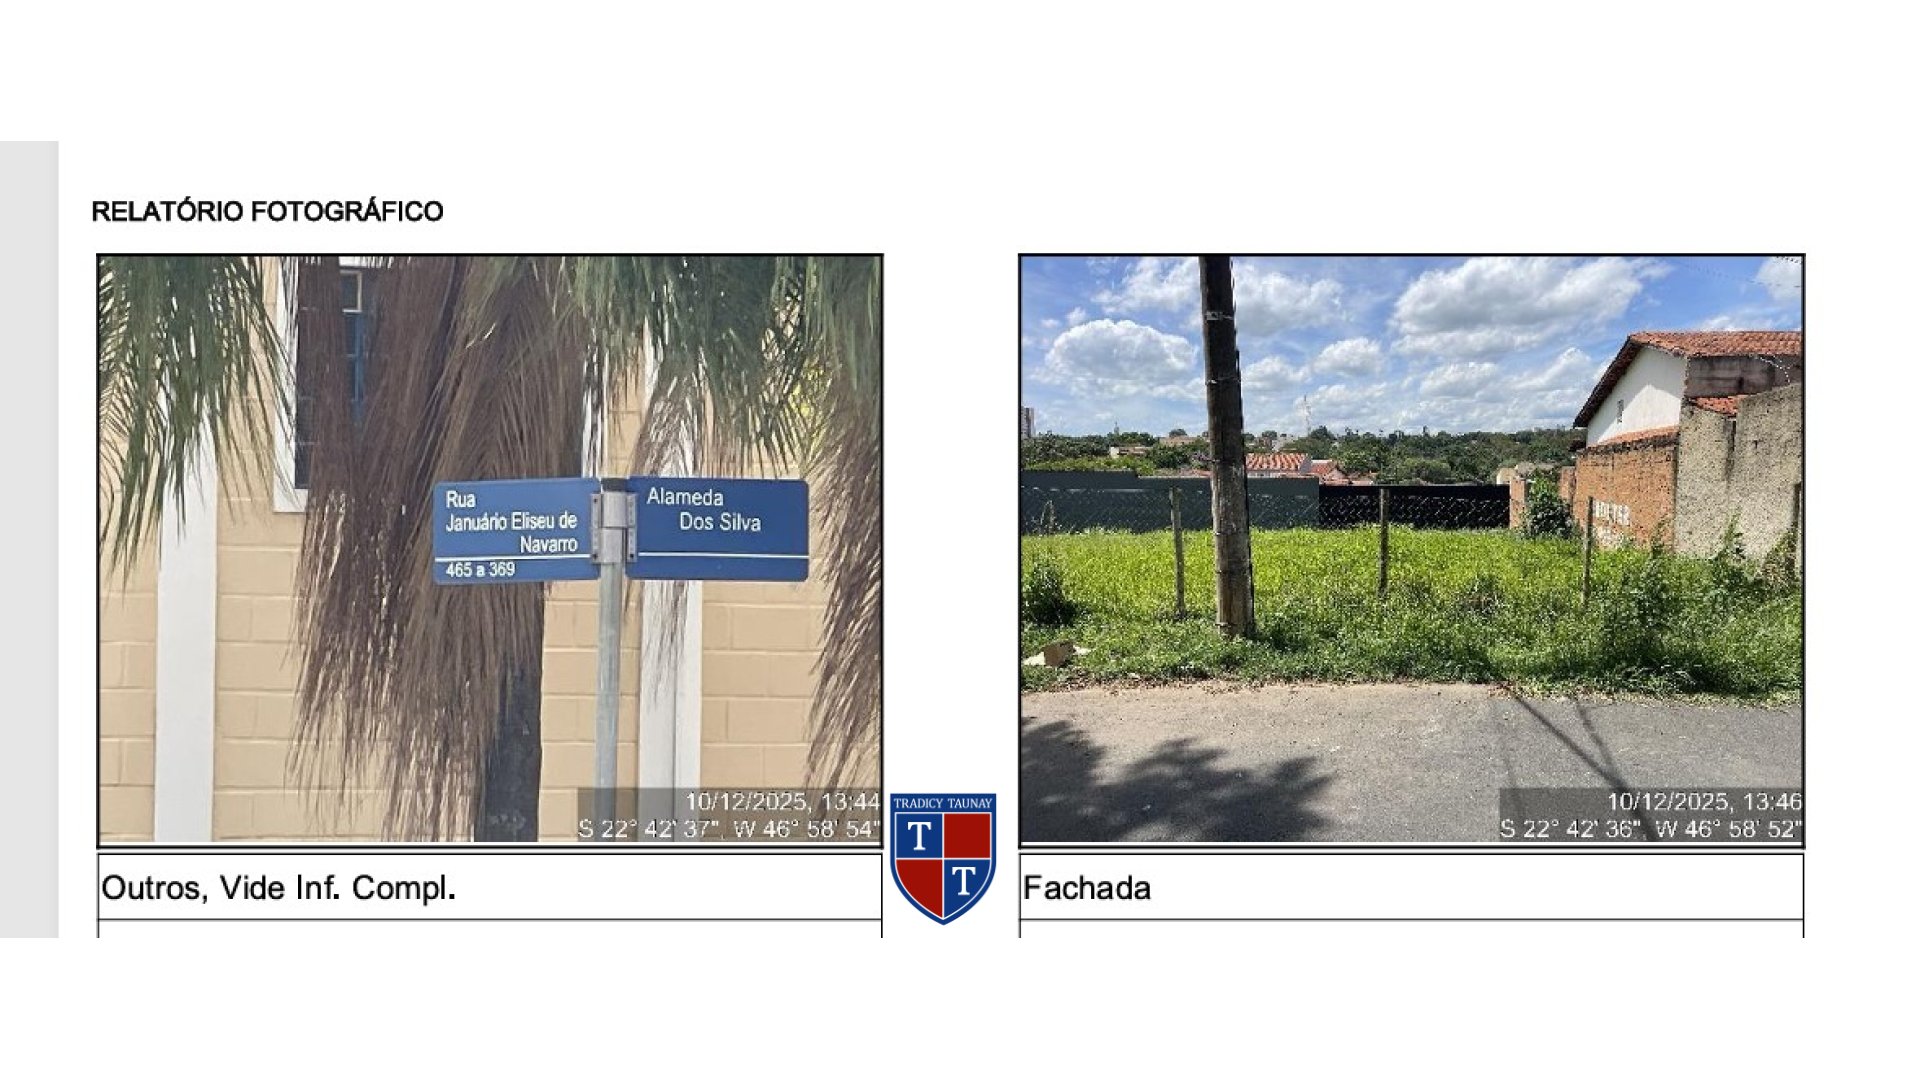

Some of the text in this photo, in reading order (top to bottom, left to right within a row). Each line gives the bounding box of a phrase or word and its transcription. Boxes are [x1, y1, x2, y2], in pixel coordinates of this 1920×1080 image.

[93, 196, 443, 222] RELATÓRIO FOTOGRÁFICO
[446, 490, 476, 508] Rua
[647, 487, 724, 506] Alameda
[445, 512, 578, 533] Januário Eliseu de
[680, 513, 761, 532] Dos Silva
[520, 535, 578, 554] Navarro
[445, 562, 516, 578] 465 a 369
[102, 874, 454, 906] Outros, Vide Inf. Compl.
[1025, 875, 1150, 899] Fachada
